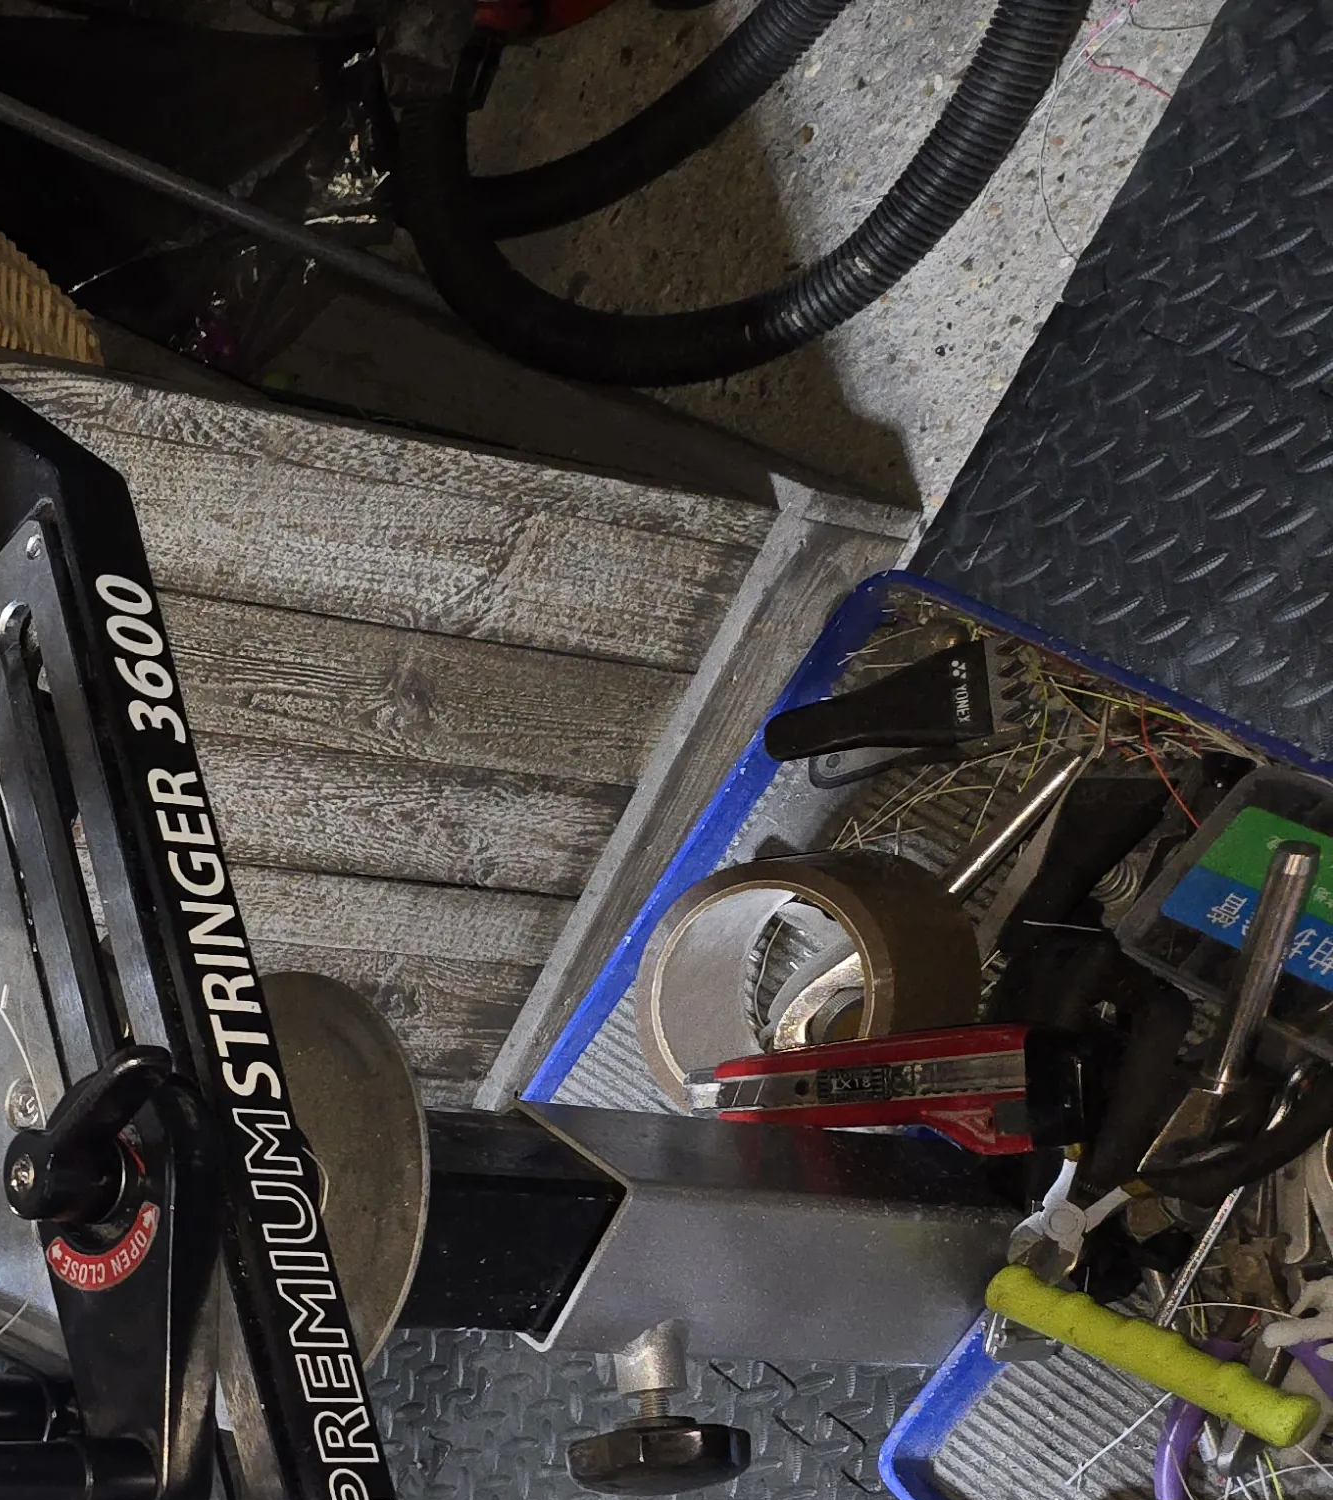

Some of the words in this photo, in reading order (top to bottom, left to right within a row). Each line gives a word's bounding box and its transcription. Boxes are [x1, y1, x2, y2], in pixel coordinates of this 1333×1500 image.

[94, 572, 187, 746] 3600
[955, 682, 972, 722] YONEX
[59, 1254, 106, 1283] CLOSE
[110, 1228, 148, 1276] OPEN
